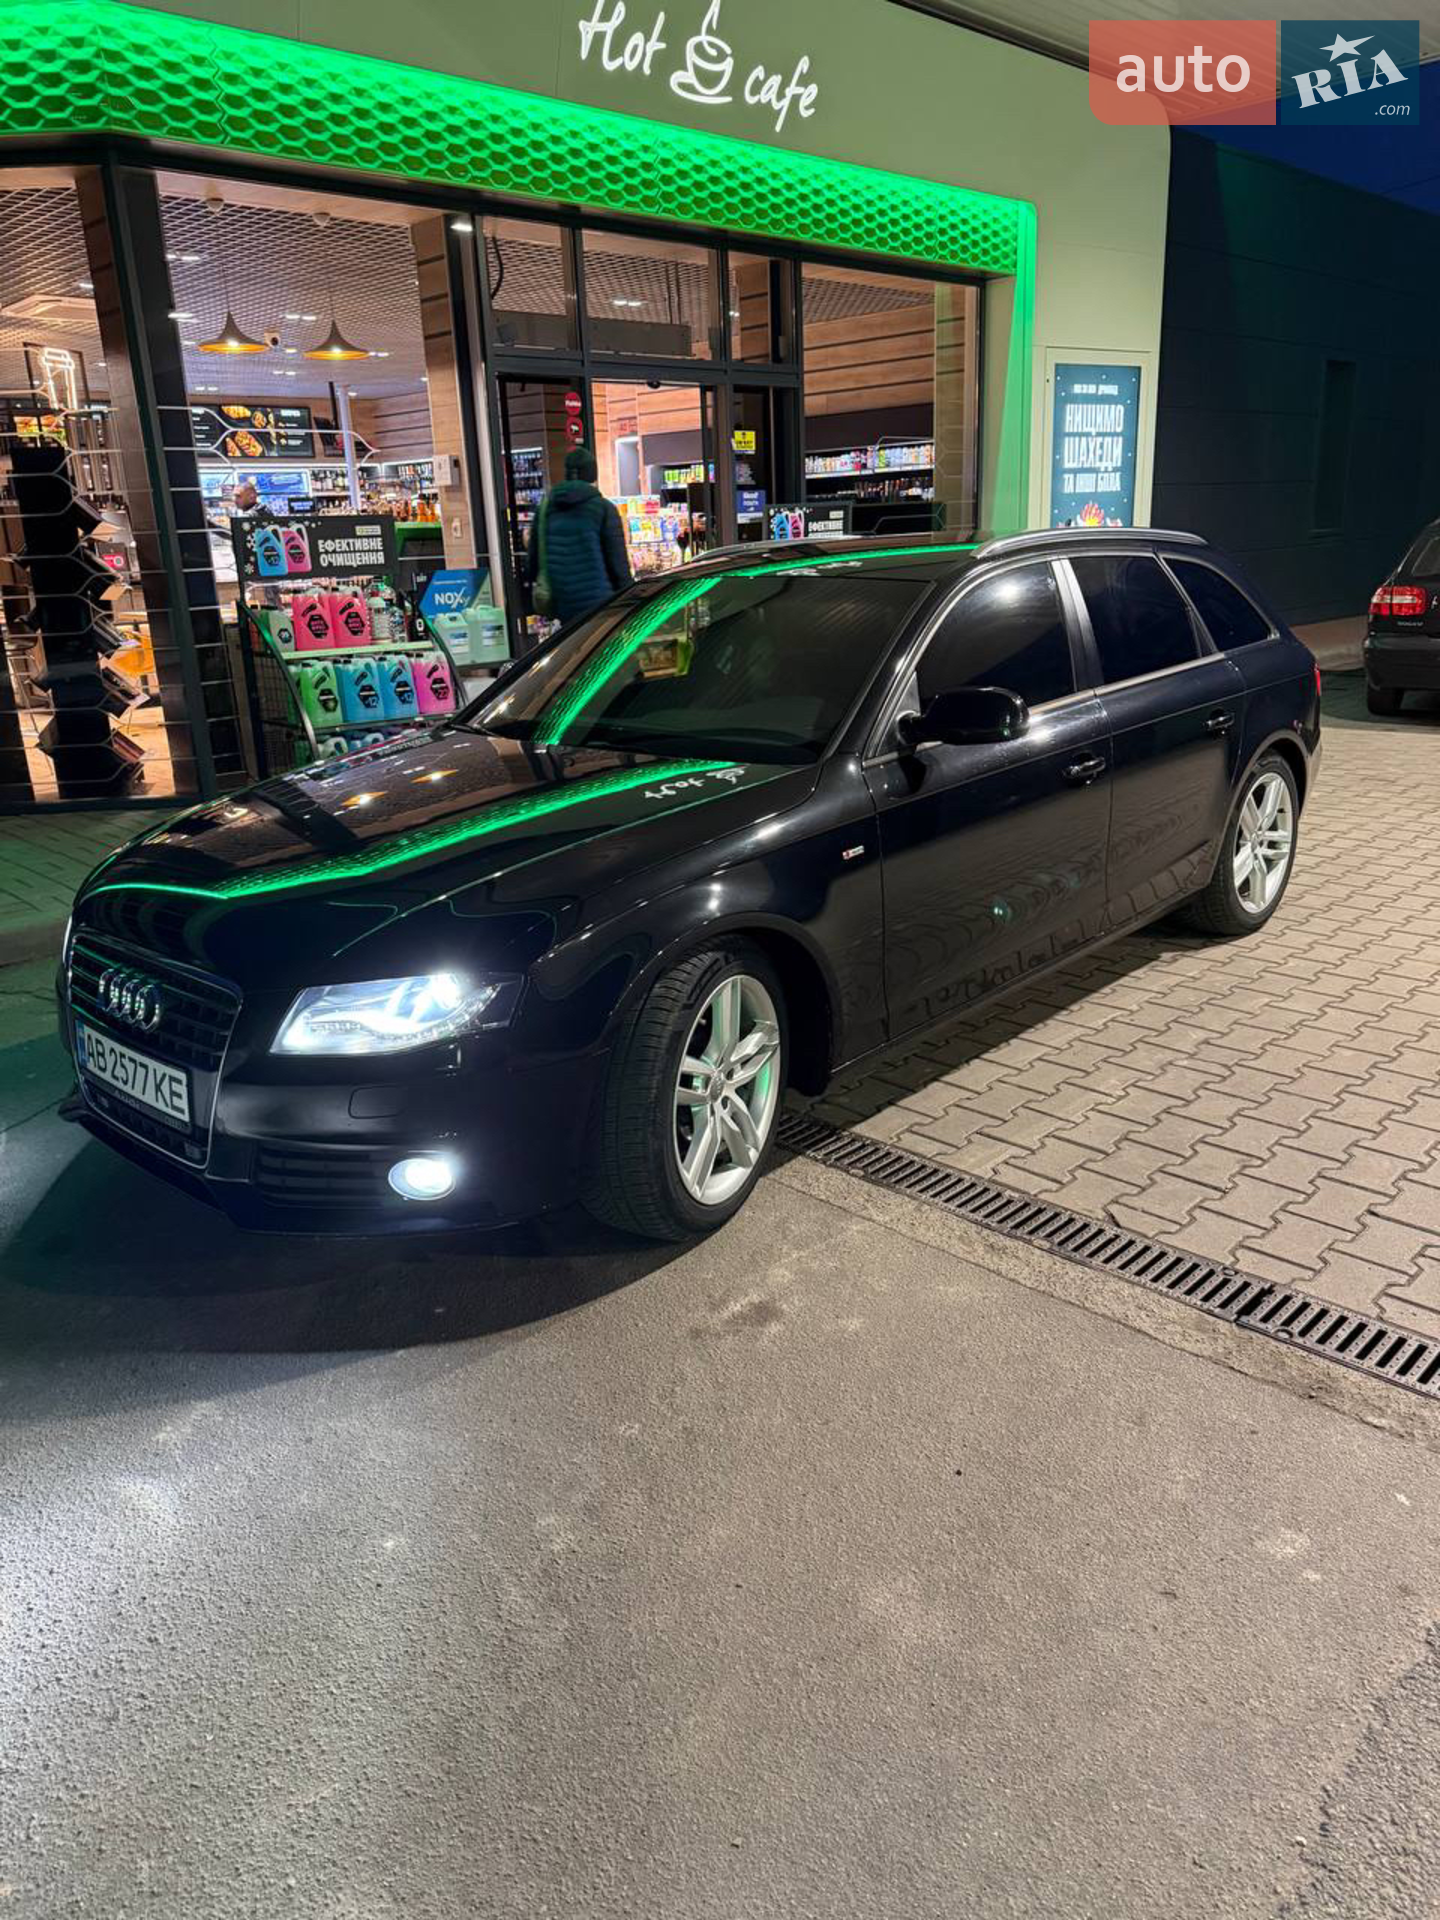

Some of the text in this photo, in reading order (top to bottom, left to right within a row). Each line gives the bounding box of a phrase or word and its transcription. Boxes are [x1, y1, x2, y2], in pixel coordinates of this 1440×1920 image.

[578, 0, 818, 133] Hot cafe
[1065, 403, 1125, 435] НИЩИМО
[1064, 436, 1123, 471] ШАХЕДИ
[318, 537, 384, 552] ЕФЕКТИВНЕ
[319, 552, 385, 567] ОЧИЩЕННЯ
[86, 1033, 107, 1074] AB
[109, 1045, 150, 1097] 2577
[152, 1066, 187, 1117] KE
